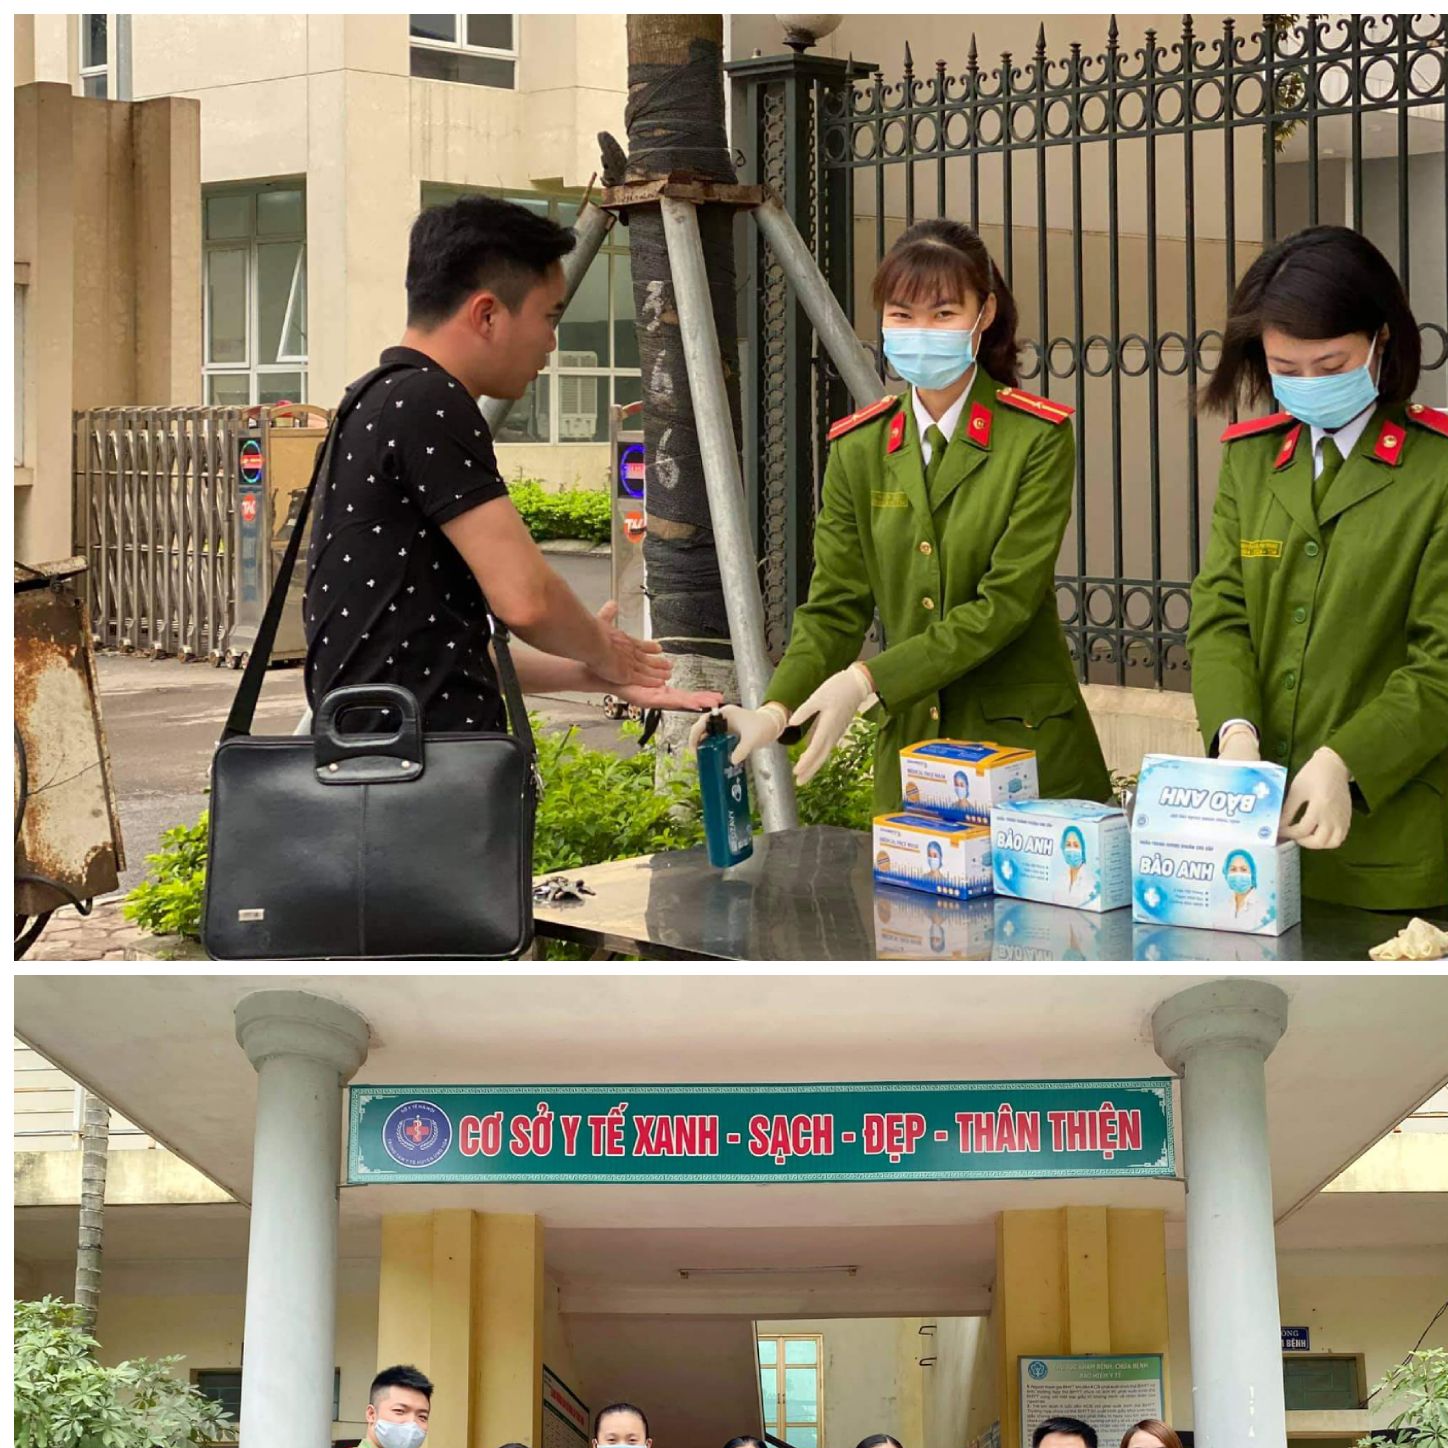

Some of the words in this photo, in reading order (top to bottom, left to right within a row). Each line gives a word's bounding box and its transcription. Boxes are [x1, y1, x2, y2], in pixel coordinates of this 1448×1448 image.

[1159, 786, 1208, 810] ANH
[1210, 791, 1257, 817] BẢO
[996, 828, 1022, 853] BẢO
[1023, 836, 1054, 857] ANH
[1139, 853, 1175, 876] BẢO
[1176, 860, 1215, 882] ANH
[459, 1111, 503, 1156] CƠ
[510, 1102, 554, 1156] SỞ
[560, 1115, 581, 1156] Y
[588, 1103, 628, 1156] TẾ
[633, 1115, 718, 1156] XANH
[749, 1114, 833, 1164] SẠCH
[863, 1113, 926, 1163] ĐẸP
[955, 1104, 1040, 1152] THÂN
[1048, 1102, 1142, 1159] THIỆN
